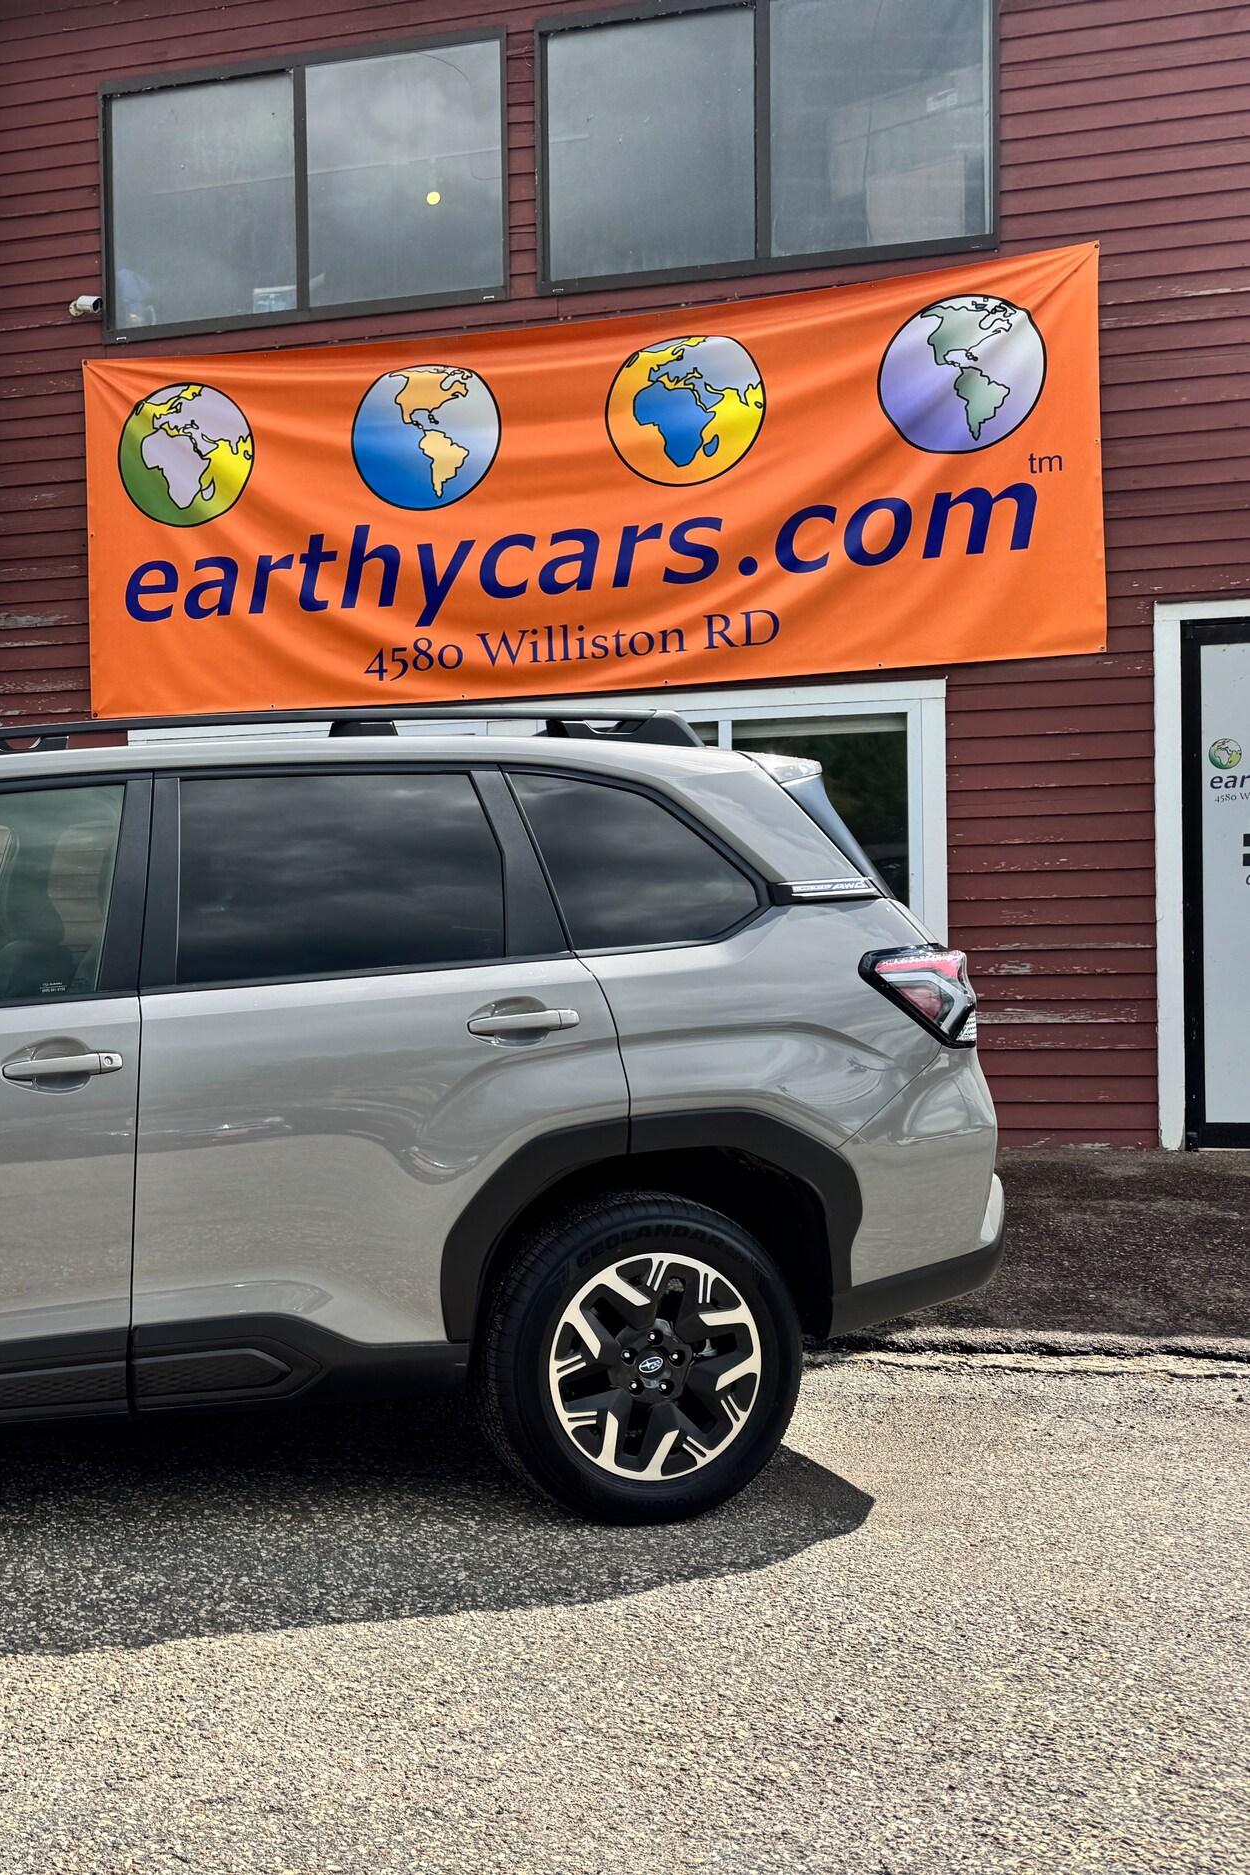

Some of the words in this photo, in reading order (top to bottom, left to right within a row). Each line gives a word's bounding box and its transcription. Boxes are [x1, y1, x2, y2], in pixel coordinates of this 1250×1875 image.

[1028, 453, 1063, 474] tm
[125, 482, 1038, 628] earthycars.com
[364, 637, 464, 682] 4580
[476, 624, 686, 667] Williston
[703, 609, 780, 650] RD
[1214, 793, 1237, 803] 4580
[576, 1224, 725, 1269] GEOLANDAR
